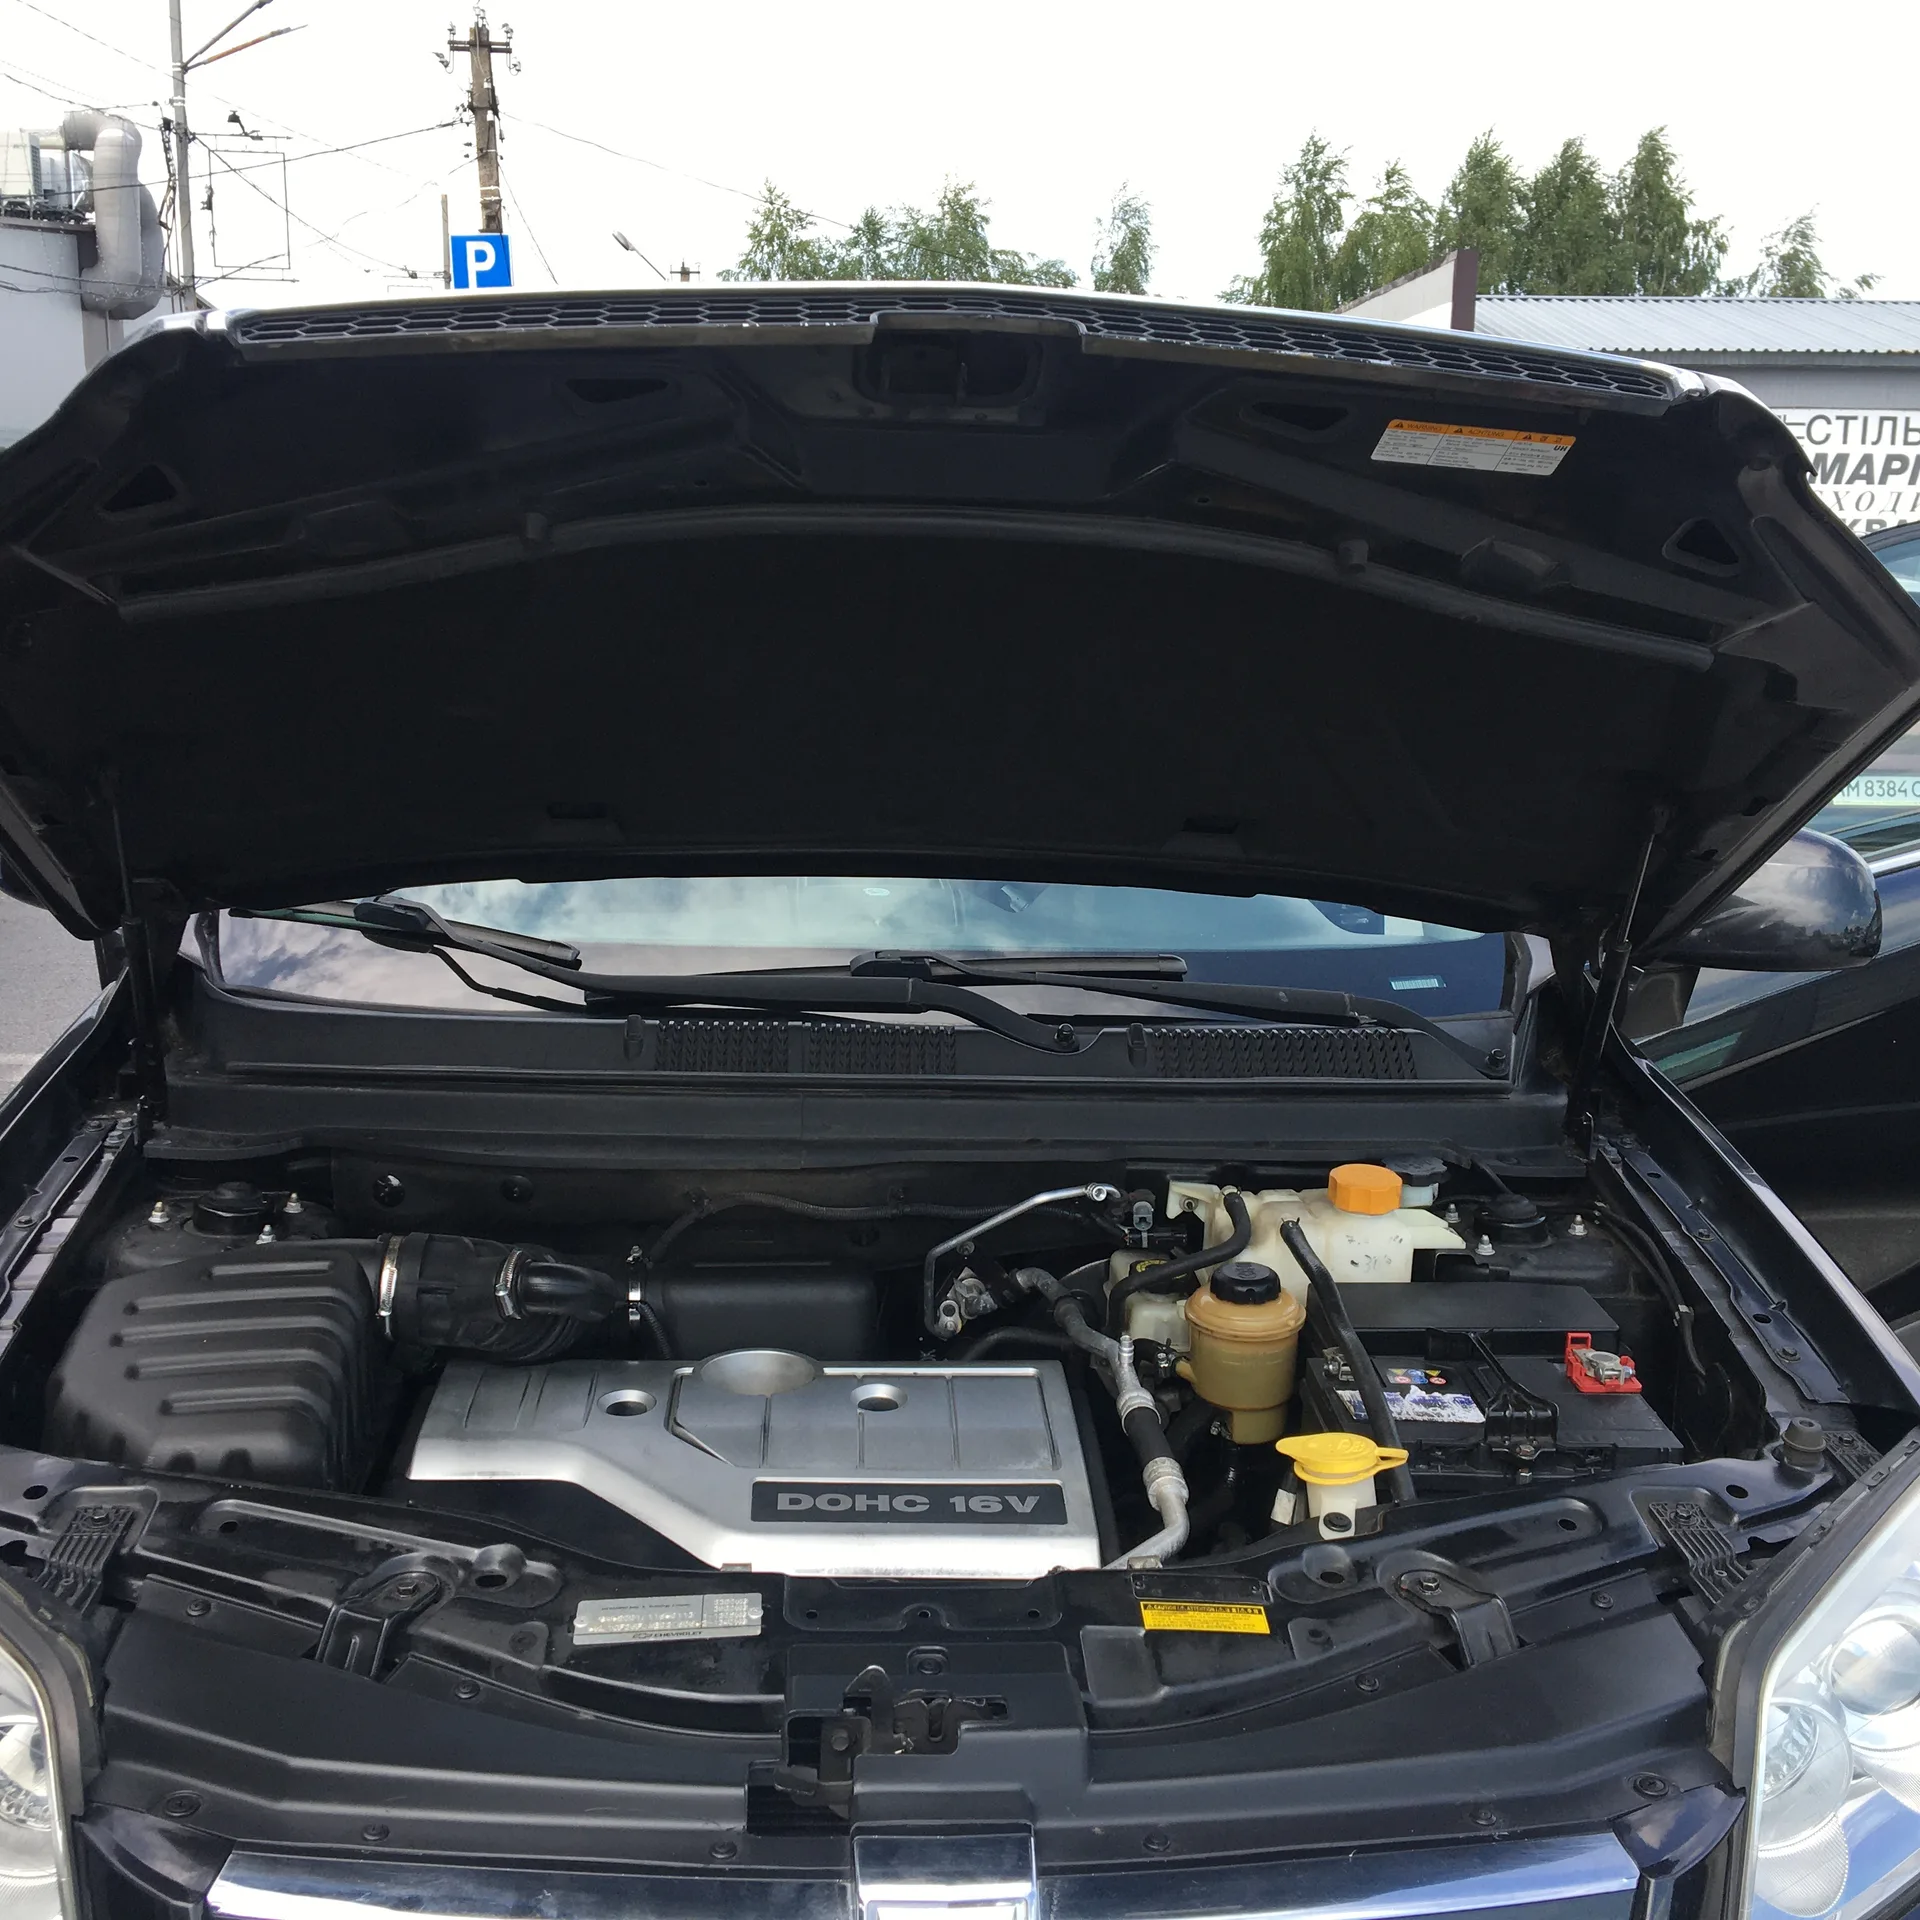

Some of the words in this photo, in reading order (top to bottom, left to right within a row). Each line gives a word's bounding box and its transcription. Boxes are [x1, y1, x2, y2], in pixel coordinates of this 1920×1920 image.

[466, 240, 496, 289] P
[1406, 423, 1442, 432] WARNING
[1467, 429, 1505, 437] ACHTUNG
[1841, 780, 1860, 798] M
[1864, 779, 1908, 798] 8384
[776, 1492, 930, 1513] DOHC
[949, 1494, 1040, 1514] 16V
[653, 1630, 703, 1638] CHEVROLET
